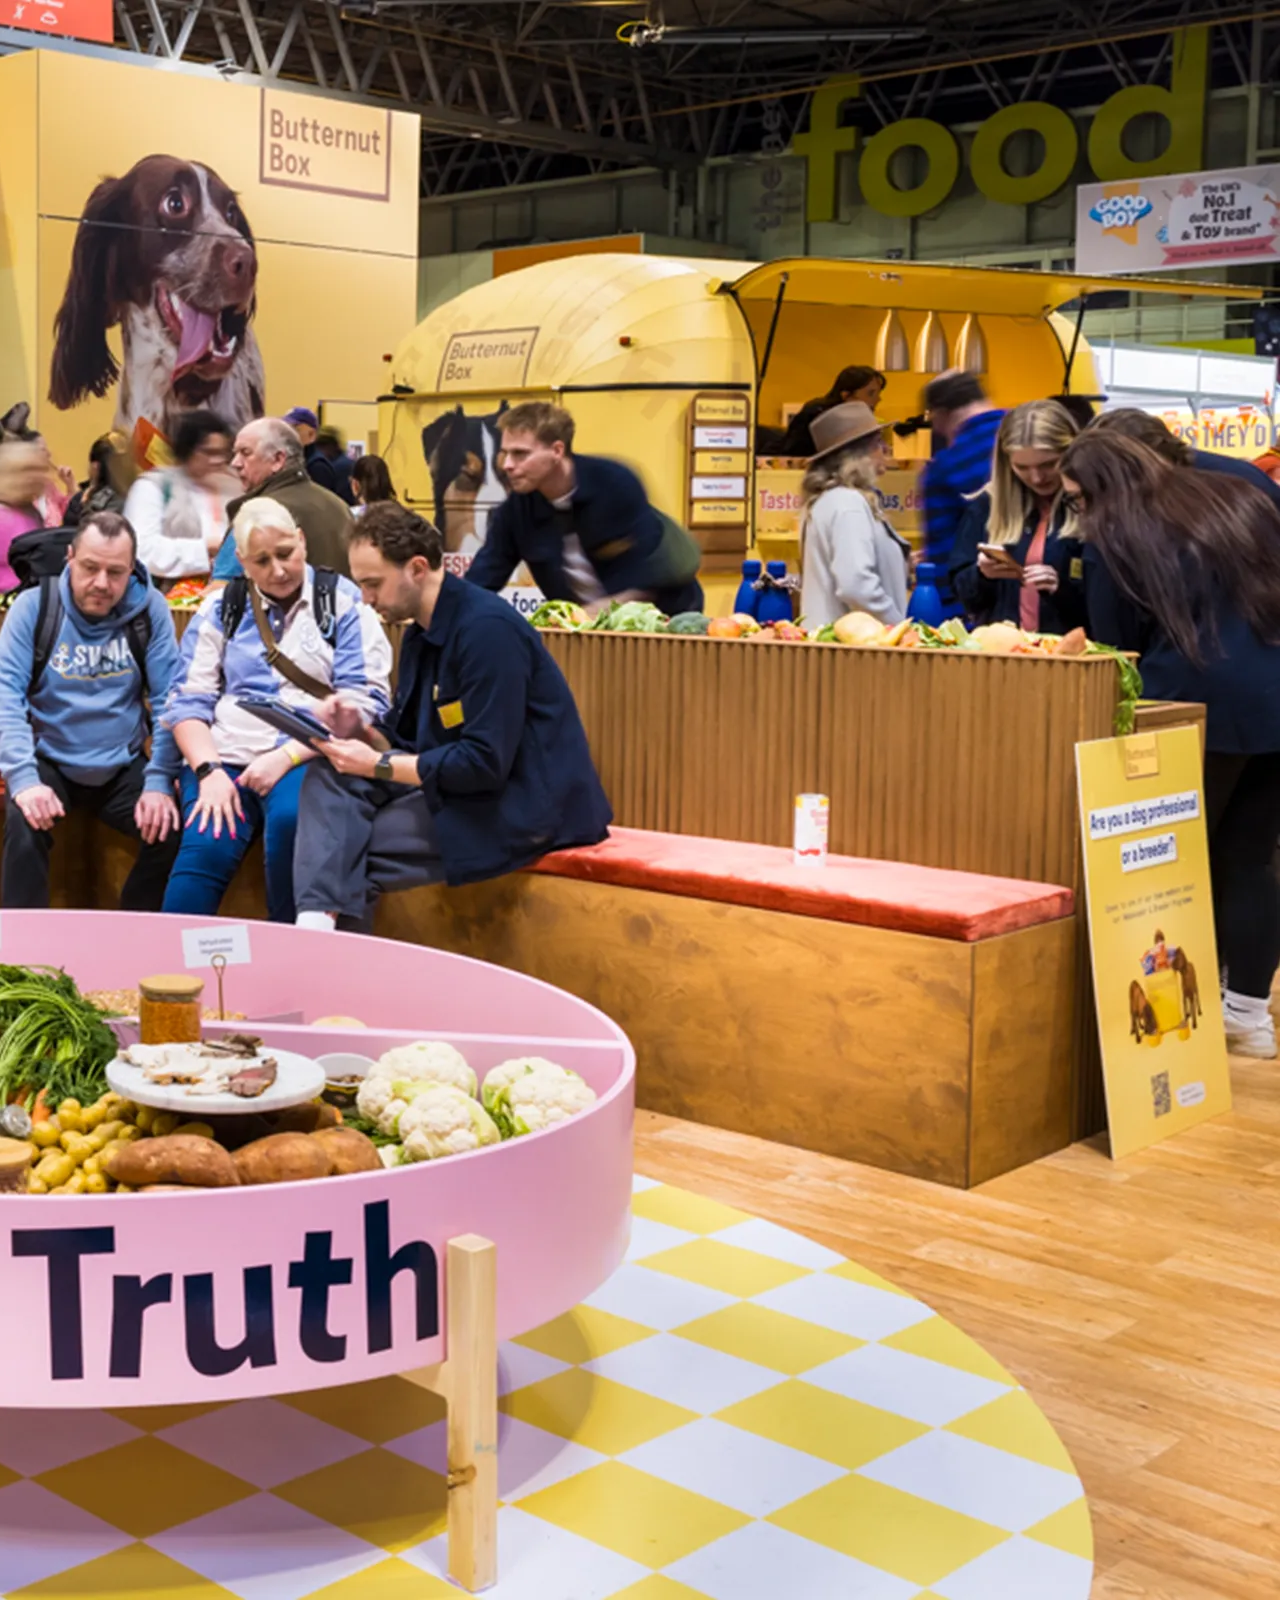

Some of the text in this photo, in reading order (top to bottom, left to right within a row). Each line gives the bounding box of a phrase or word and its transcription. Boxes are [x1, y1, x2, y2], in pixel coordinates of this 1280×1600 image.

[270, 108, 381, 155] Butternut
[793, 26, 1209, 223] food
[270, 142, 311, 176] Box
[1095, 195, 1150, 214] GOOD
[1203, 193, 1235, 209] No.1
[1102, 209, 1140, 228] BOY
[1211, 207, 1252, 222] Treat
[449, 340, 527, 360] Butternut
[445, 362, 473, 381] Box
[1090, 794, 1198, 832] Are you a dog professional
[1121, 835, 1174, 864] or a breeder?
[11, 1199, 440, 1381] Truth
